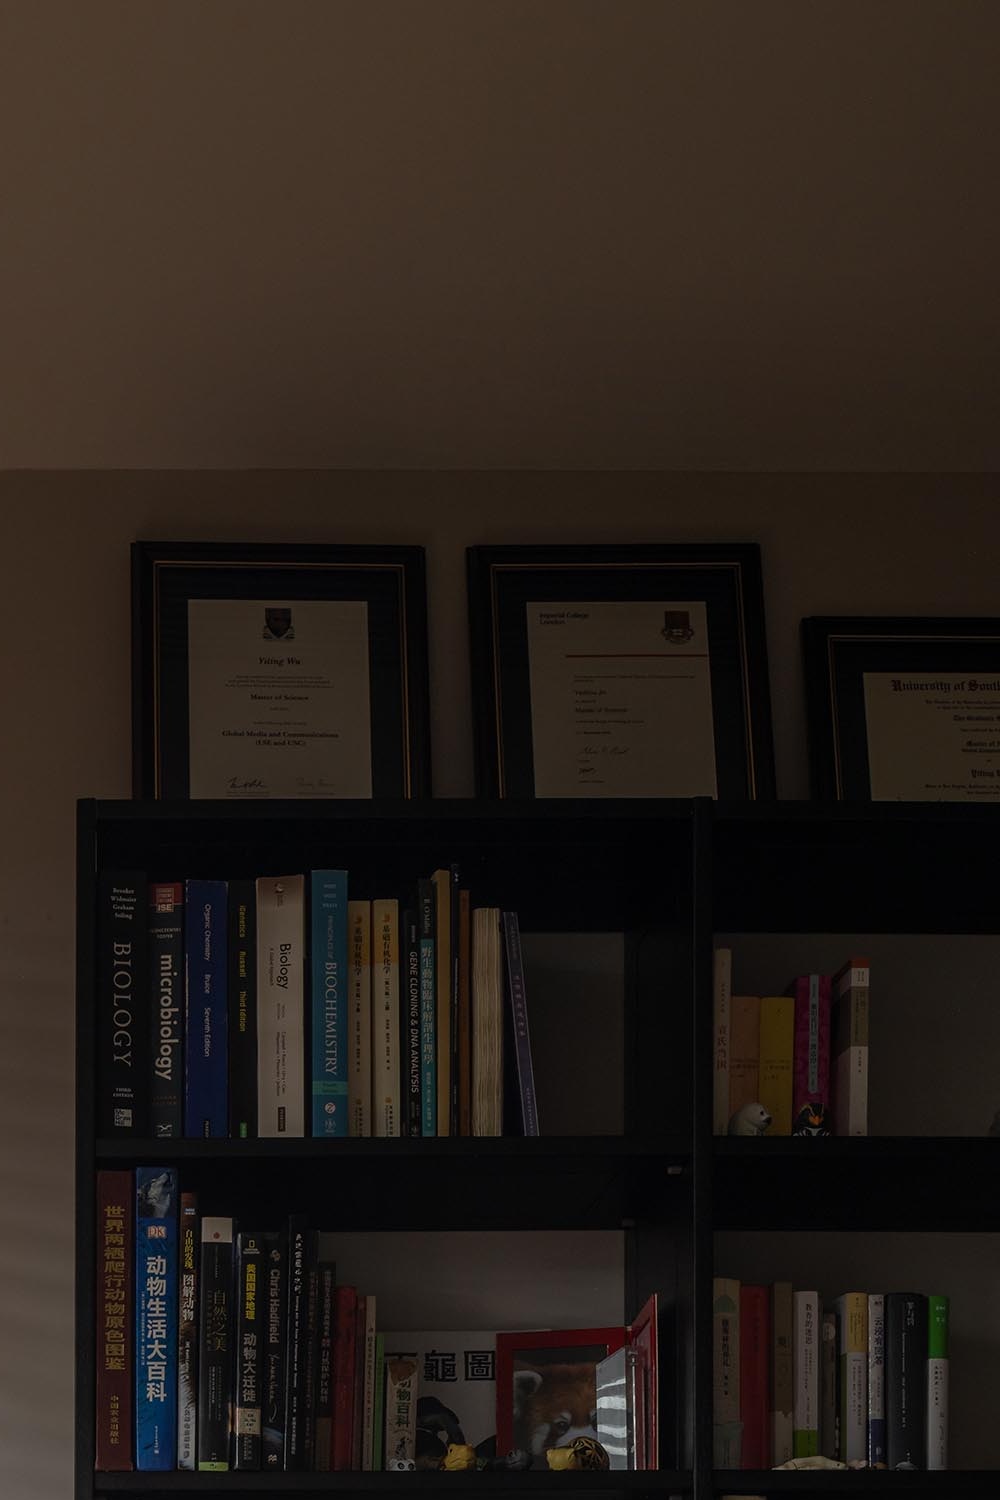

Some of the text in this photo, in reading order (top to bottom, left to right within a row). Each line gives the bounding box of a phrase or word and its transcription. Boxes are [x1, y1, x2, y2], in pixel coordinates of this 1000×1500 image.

[891, 680, 951, 693] University
[953, 680, 965, 691] of
[203, 904, 211, 929] Organic
[203, 930, 211, 961] Chemistry
[277, 943, 292, 990] Biology
[409, 951, 419, 976] GENE
[113, 942, 132, 1068] BIOLOGY
[155, 954, 180, 1081] microbiology
[324, 961, 337, 1076] BIOCHEMISTRY
[409, 977, 419, 1017] CLONING
[410, 1028, 419, 1048] DNA
[410, 1050, 419, 1093] ANALYSIS
[147, 1226, 166, 1240] DK
[268, 1269, 280, 1343] Chris Hadfield
[146, 1255, 167, 1403] 动物生活大百科
[242, 1263, 257, 1403] 美国国家地理 动物大迁徙
